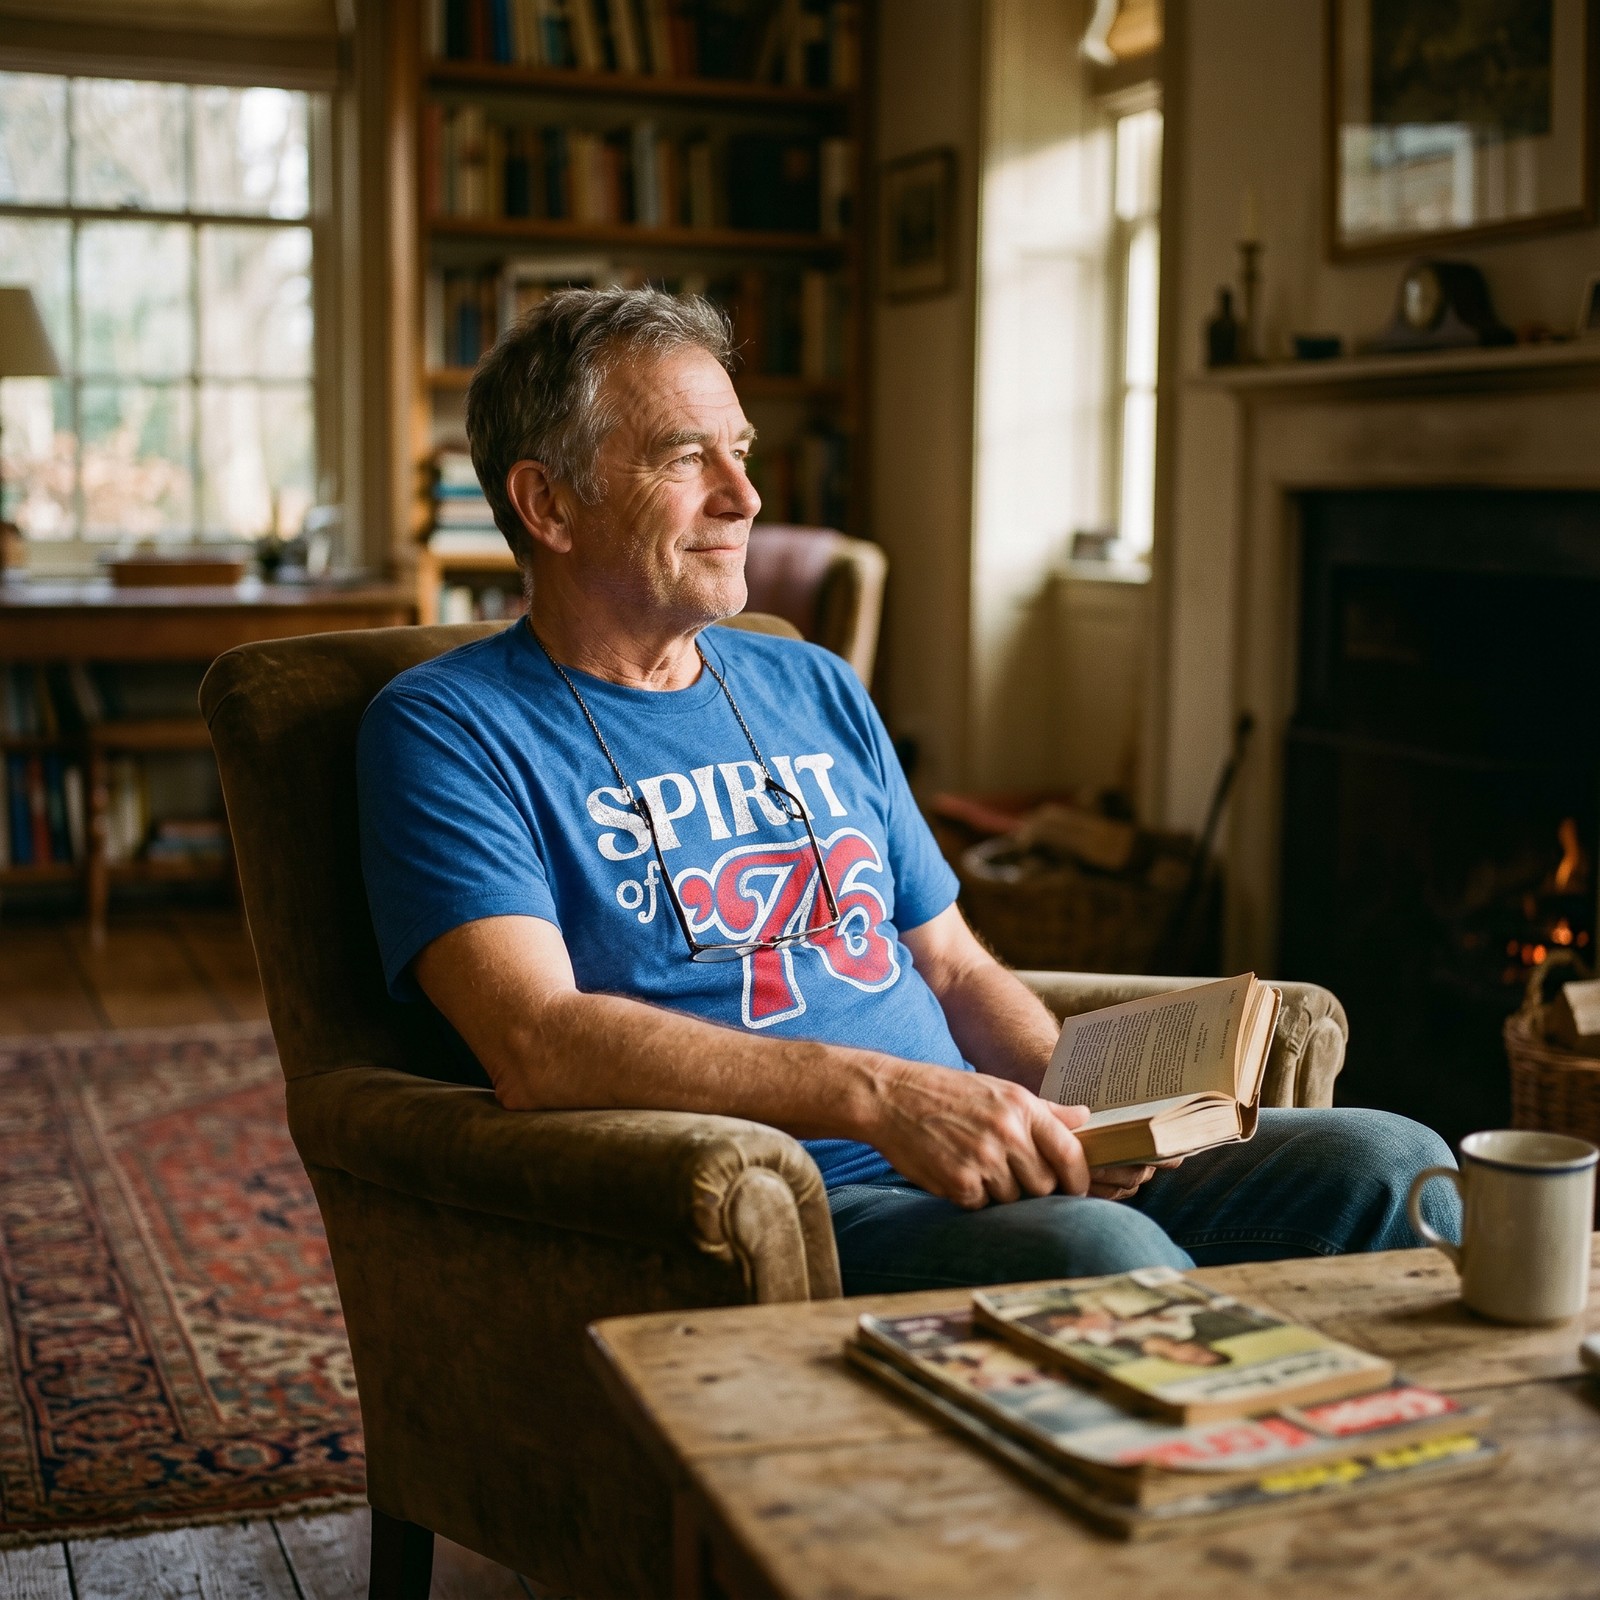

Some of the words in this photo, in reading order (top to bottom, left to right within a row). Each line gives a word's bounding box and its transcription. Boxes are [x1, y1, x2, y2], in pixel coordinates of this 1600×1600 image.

[586, 753, 848, 861] SPIRIT
[615, 860, 662, 924] of
[672, 827, 901, 1029] '76
